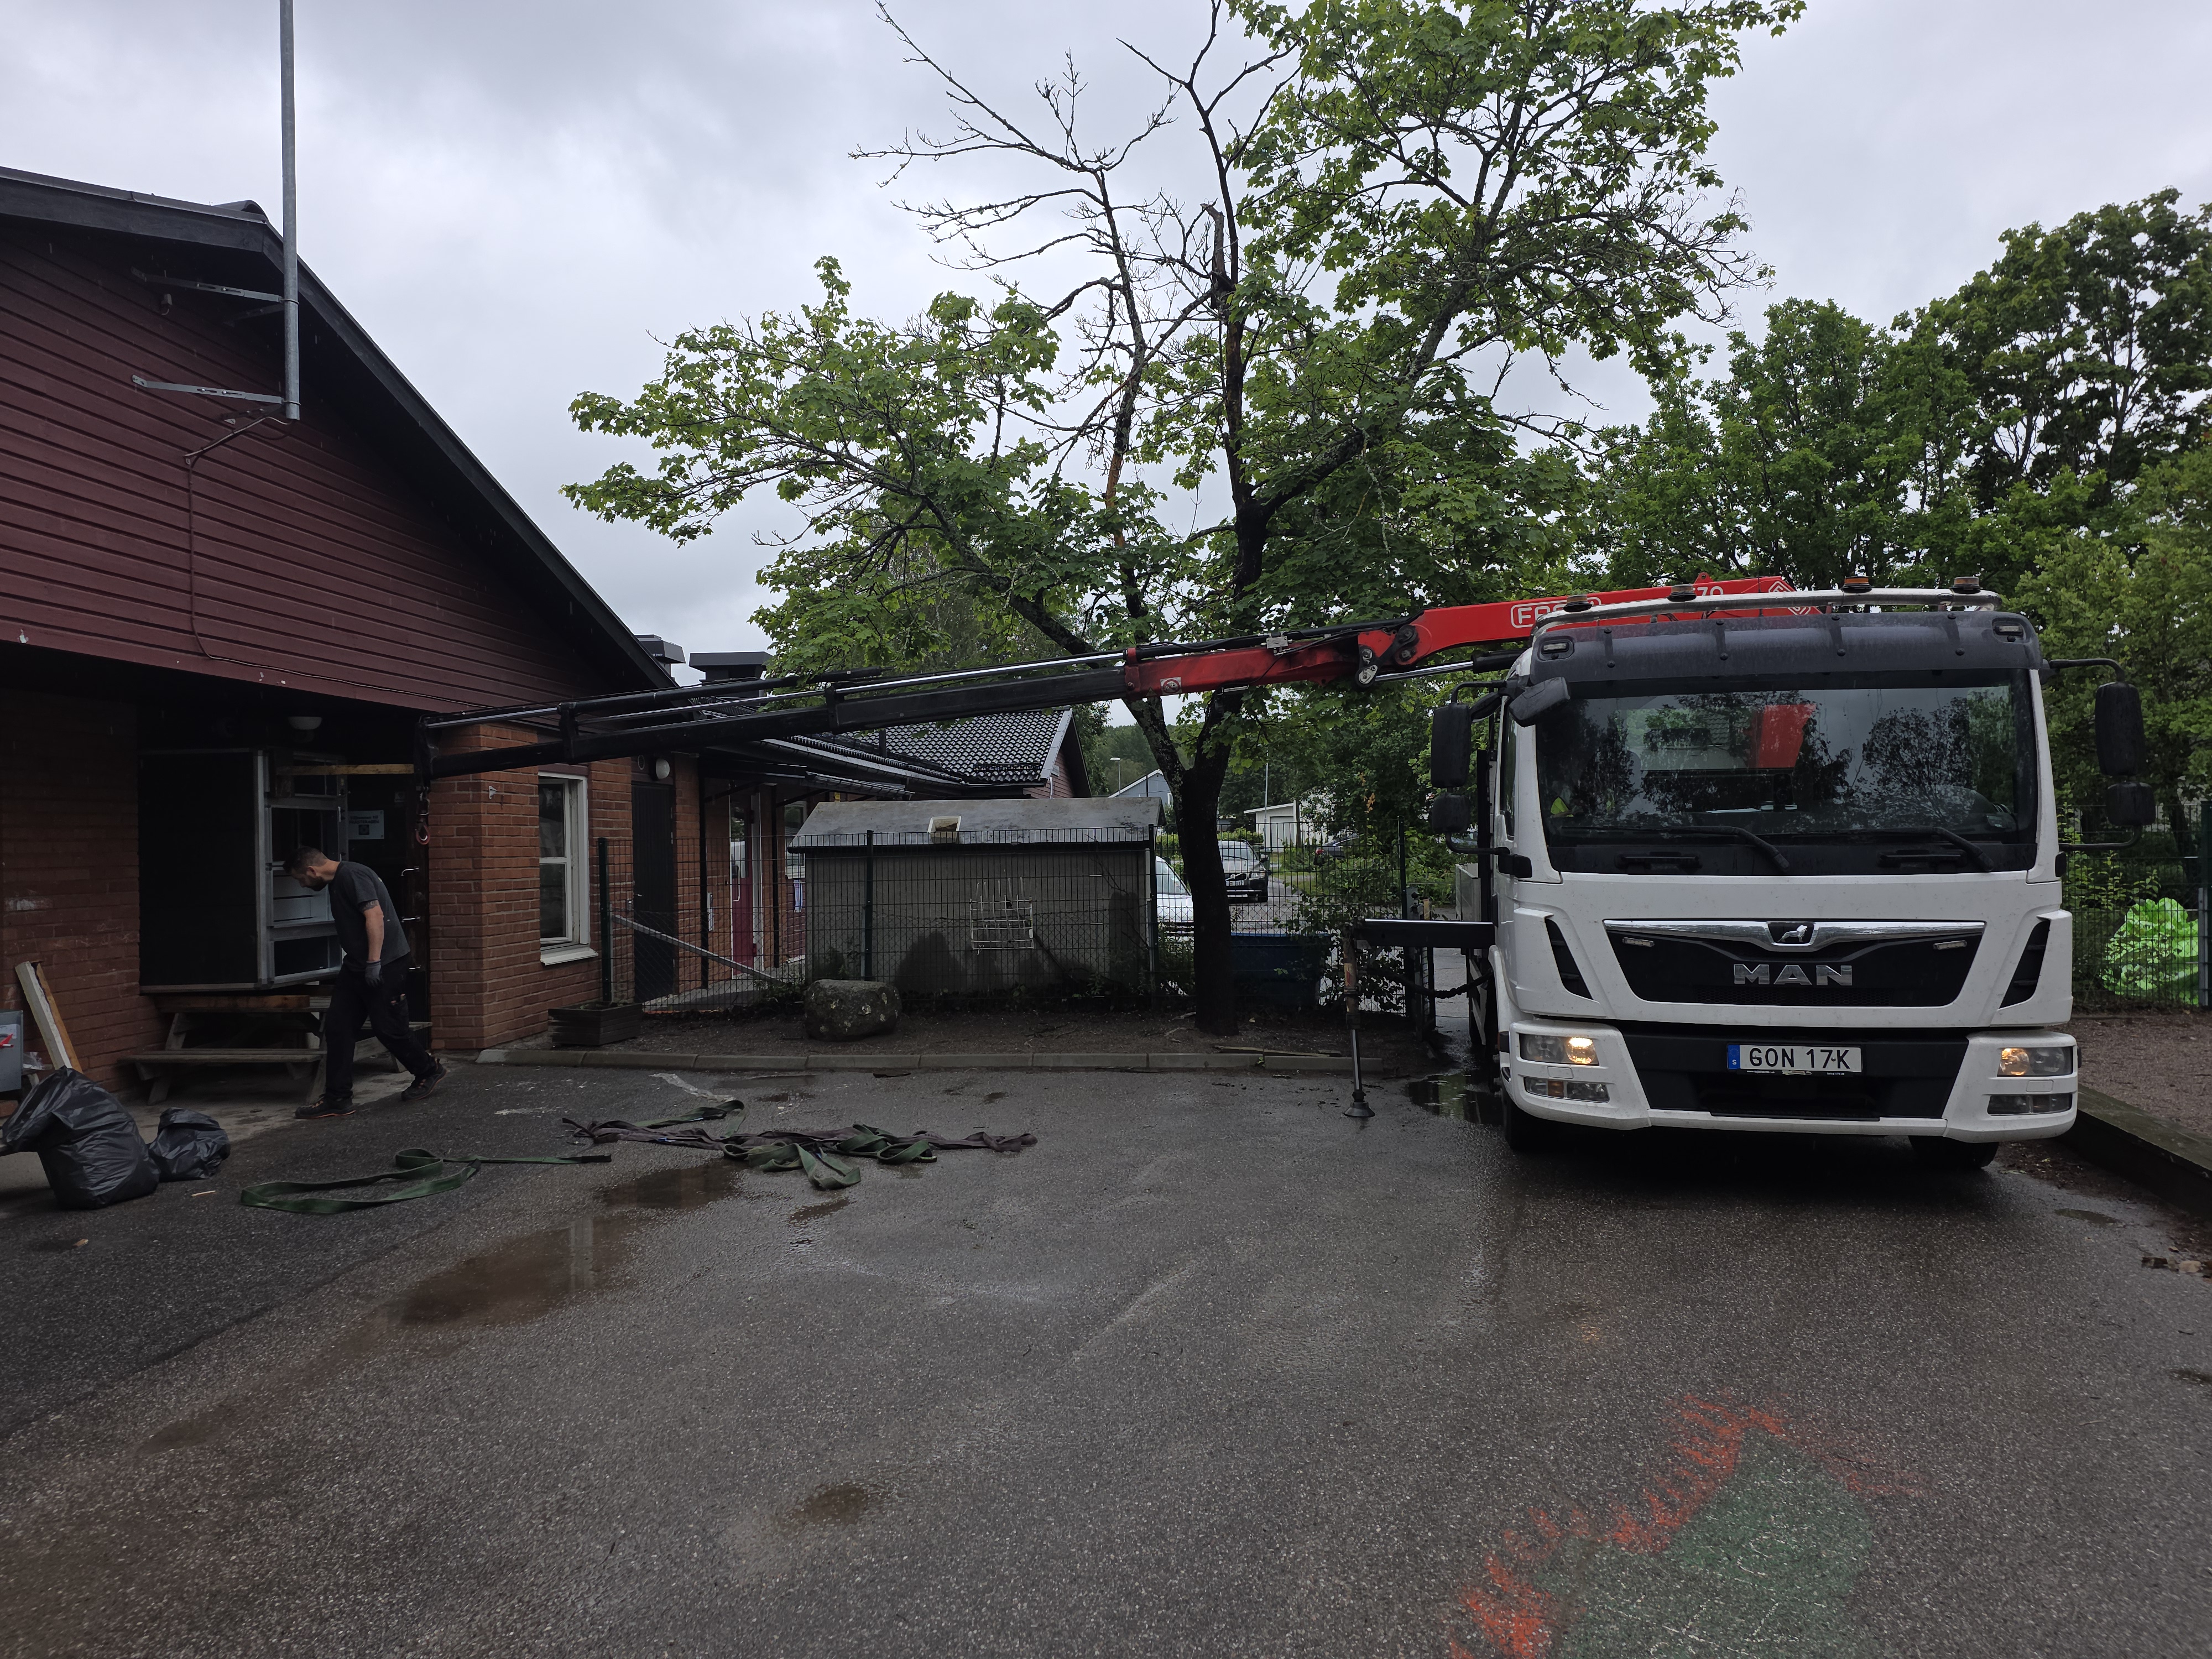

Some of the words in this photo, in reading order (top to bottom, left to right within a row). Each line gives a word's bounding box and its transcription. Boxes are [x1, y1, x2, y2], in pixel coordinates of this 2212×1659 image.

[1734, 964, 1852, 985] MAN
[1749, 1047, 1794, 1068] GON
[1806, 1048, 1850, 1070] 17K
